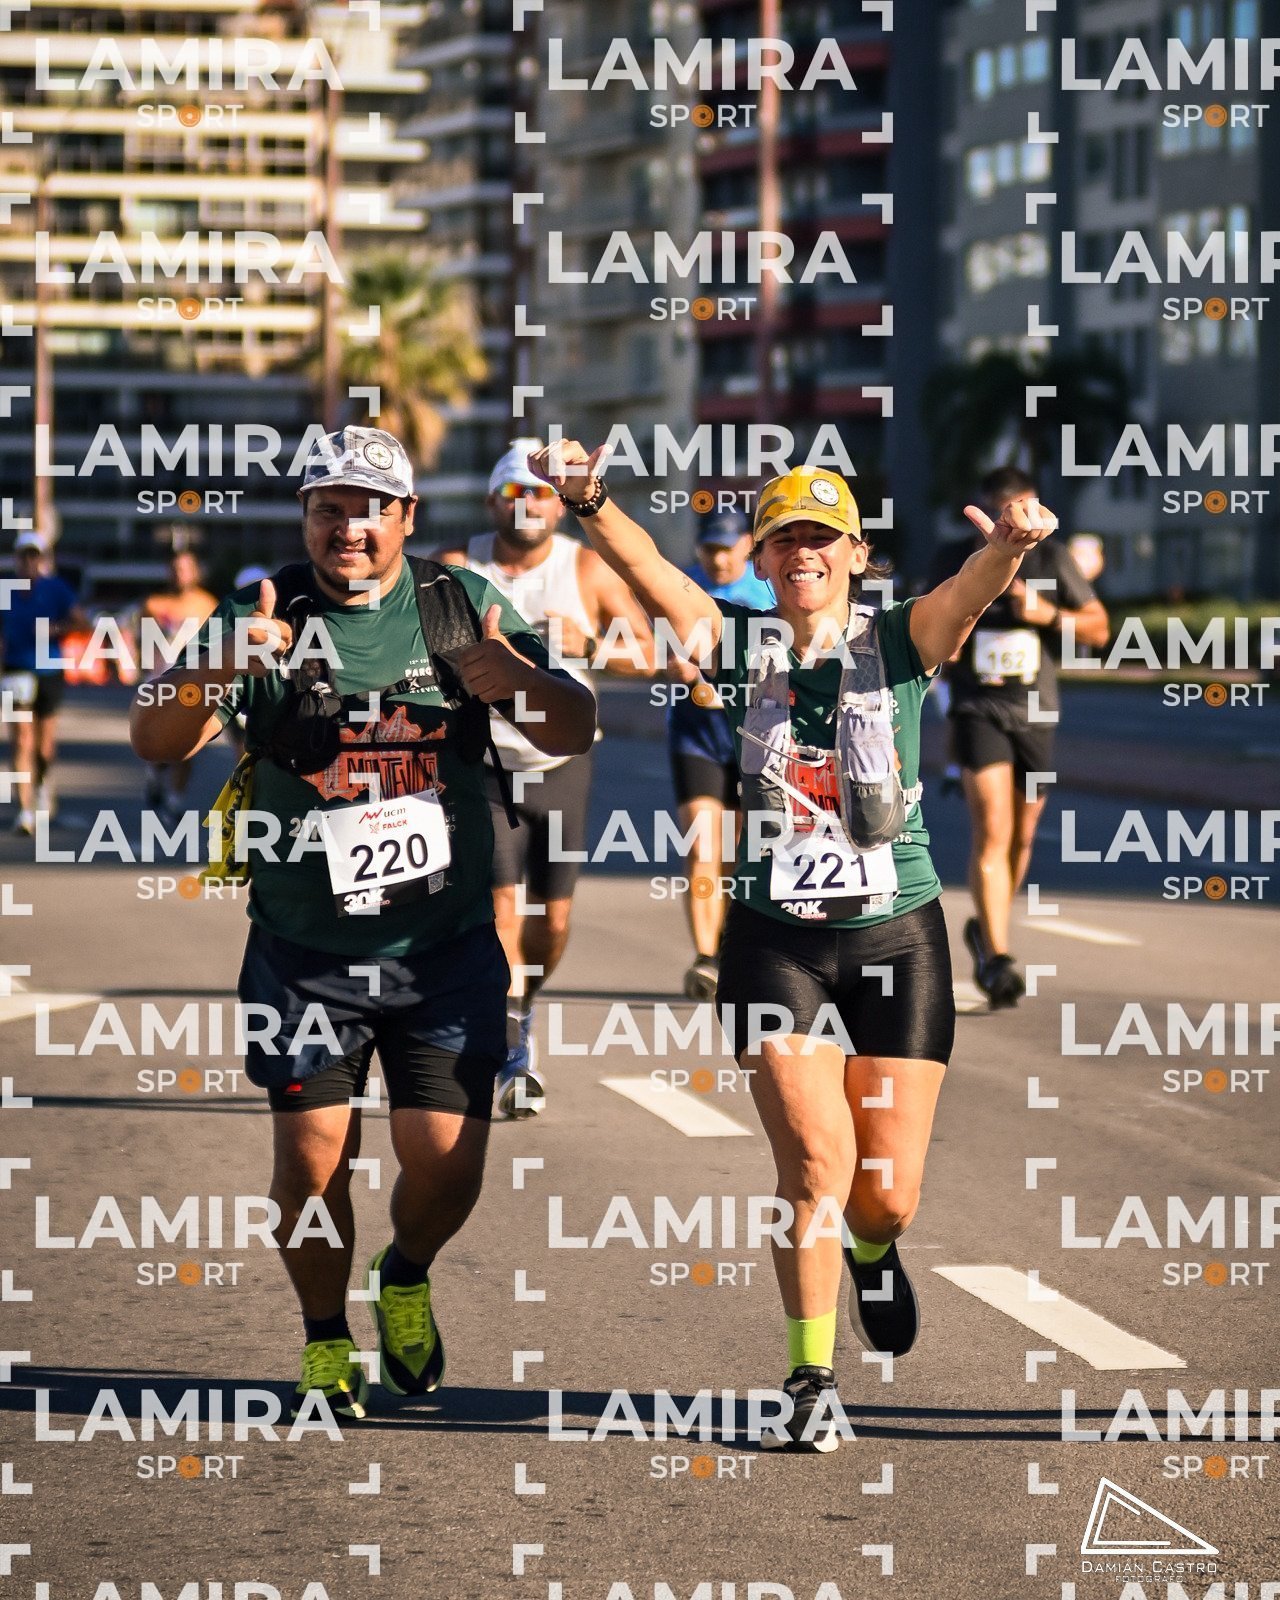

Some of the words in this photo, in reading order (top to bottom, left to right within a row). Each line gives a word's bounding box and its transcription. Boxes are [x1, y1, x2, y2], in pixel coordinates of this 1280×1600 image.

[987, 650, 1026, 669] 162
[350, 833, 429, 883] 220
[793, 852, 868, 891] 221
[344, 888, 386, 912] 30K
